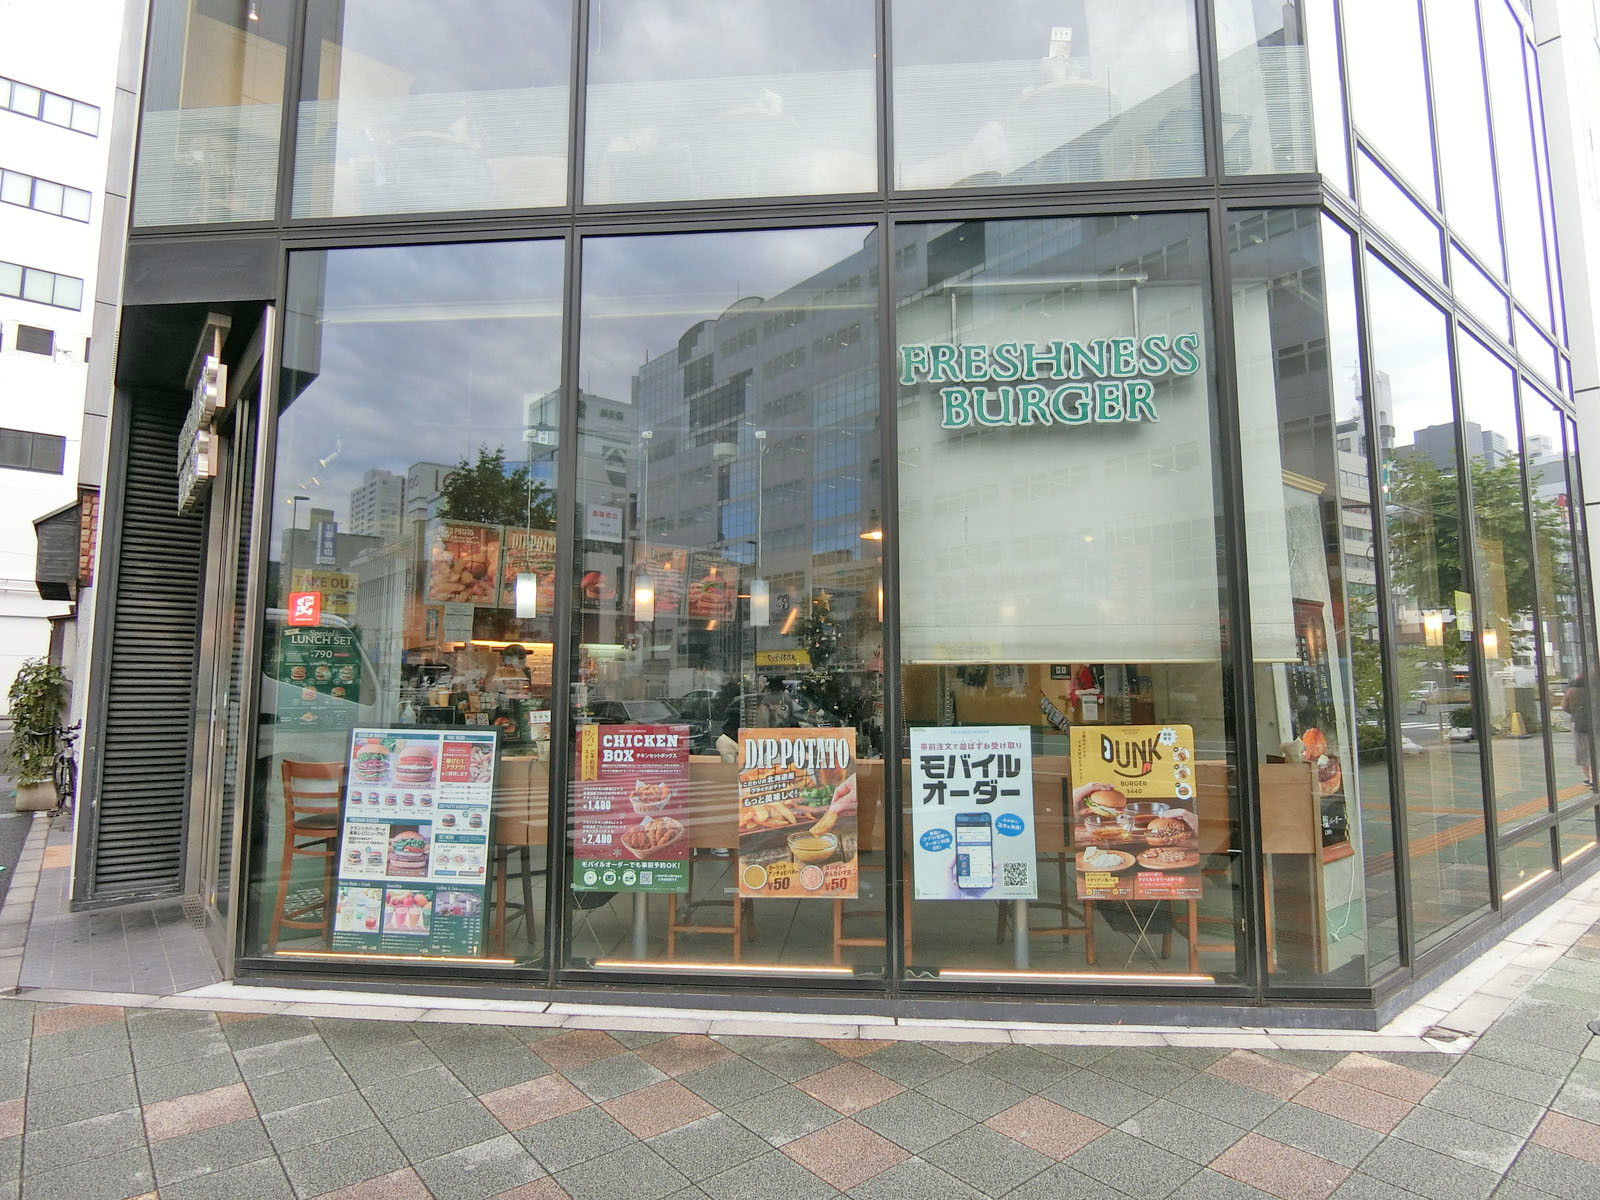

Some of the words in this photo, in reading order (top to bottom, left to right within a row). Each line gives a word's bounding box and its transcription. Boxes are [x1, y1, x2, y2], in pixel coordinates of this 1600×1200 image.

[900, 332, 1199, 385] FRESHNESS
[941, 380, 1160, 429] BURGER
[291, 635, 331, 645] LUNCH
[333, 636, 353, 645] SET
[602, 734, 679, 748] CHICKEN
[1100, 732, 1163, 769] DUNK
[602, 749, 635, 762] BOX
[920, 754, 1021, 779] モバイル
[923, 779, 1021, 805] オーダー
[768, 877, 790, 890] ¥50
[825, 877, 847, 890] ¥50
